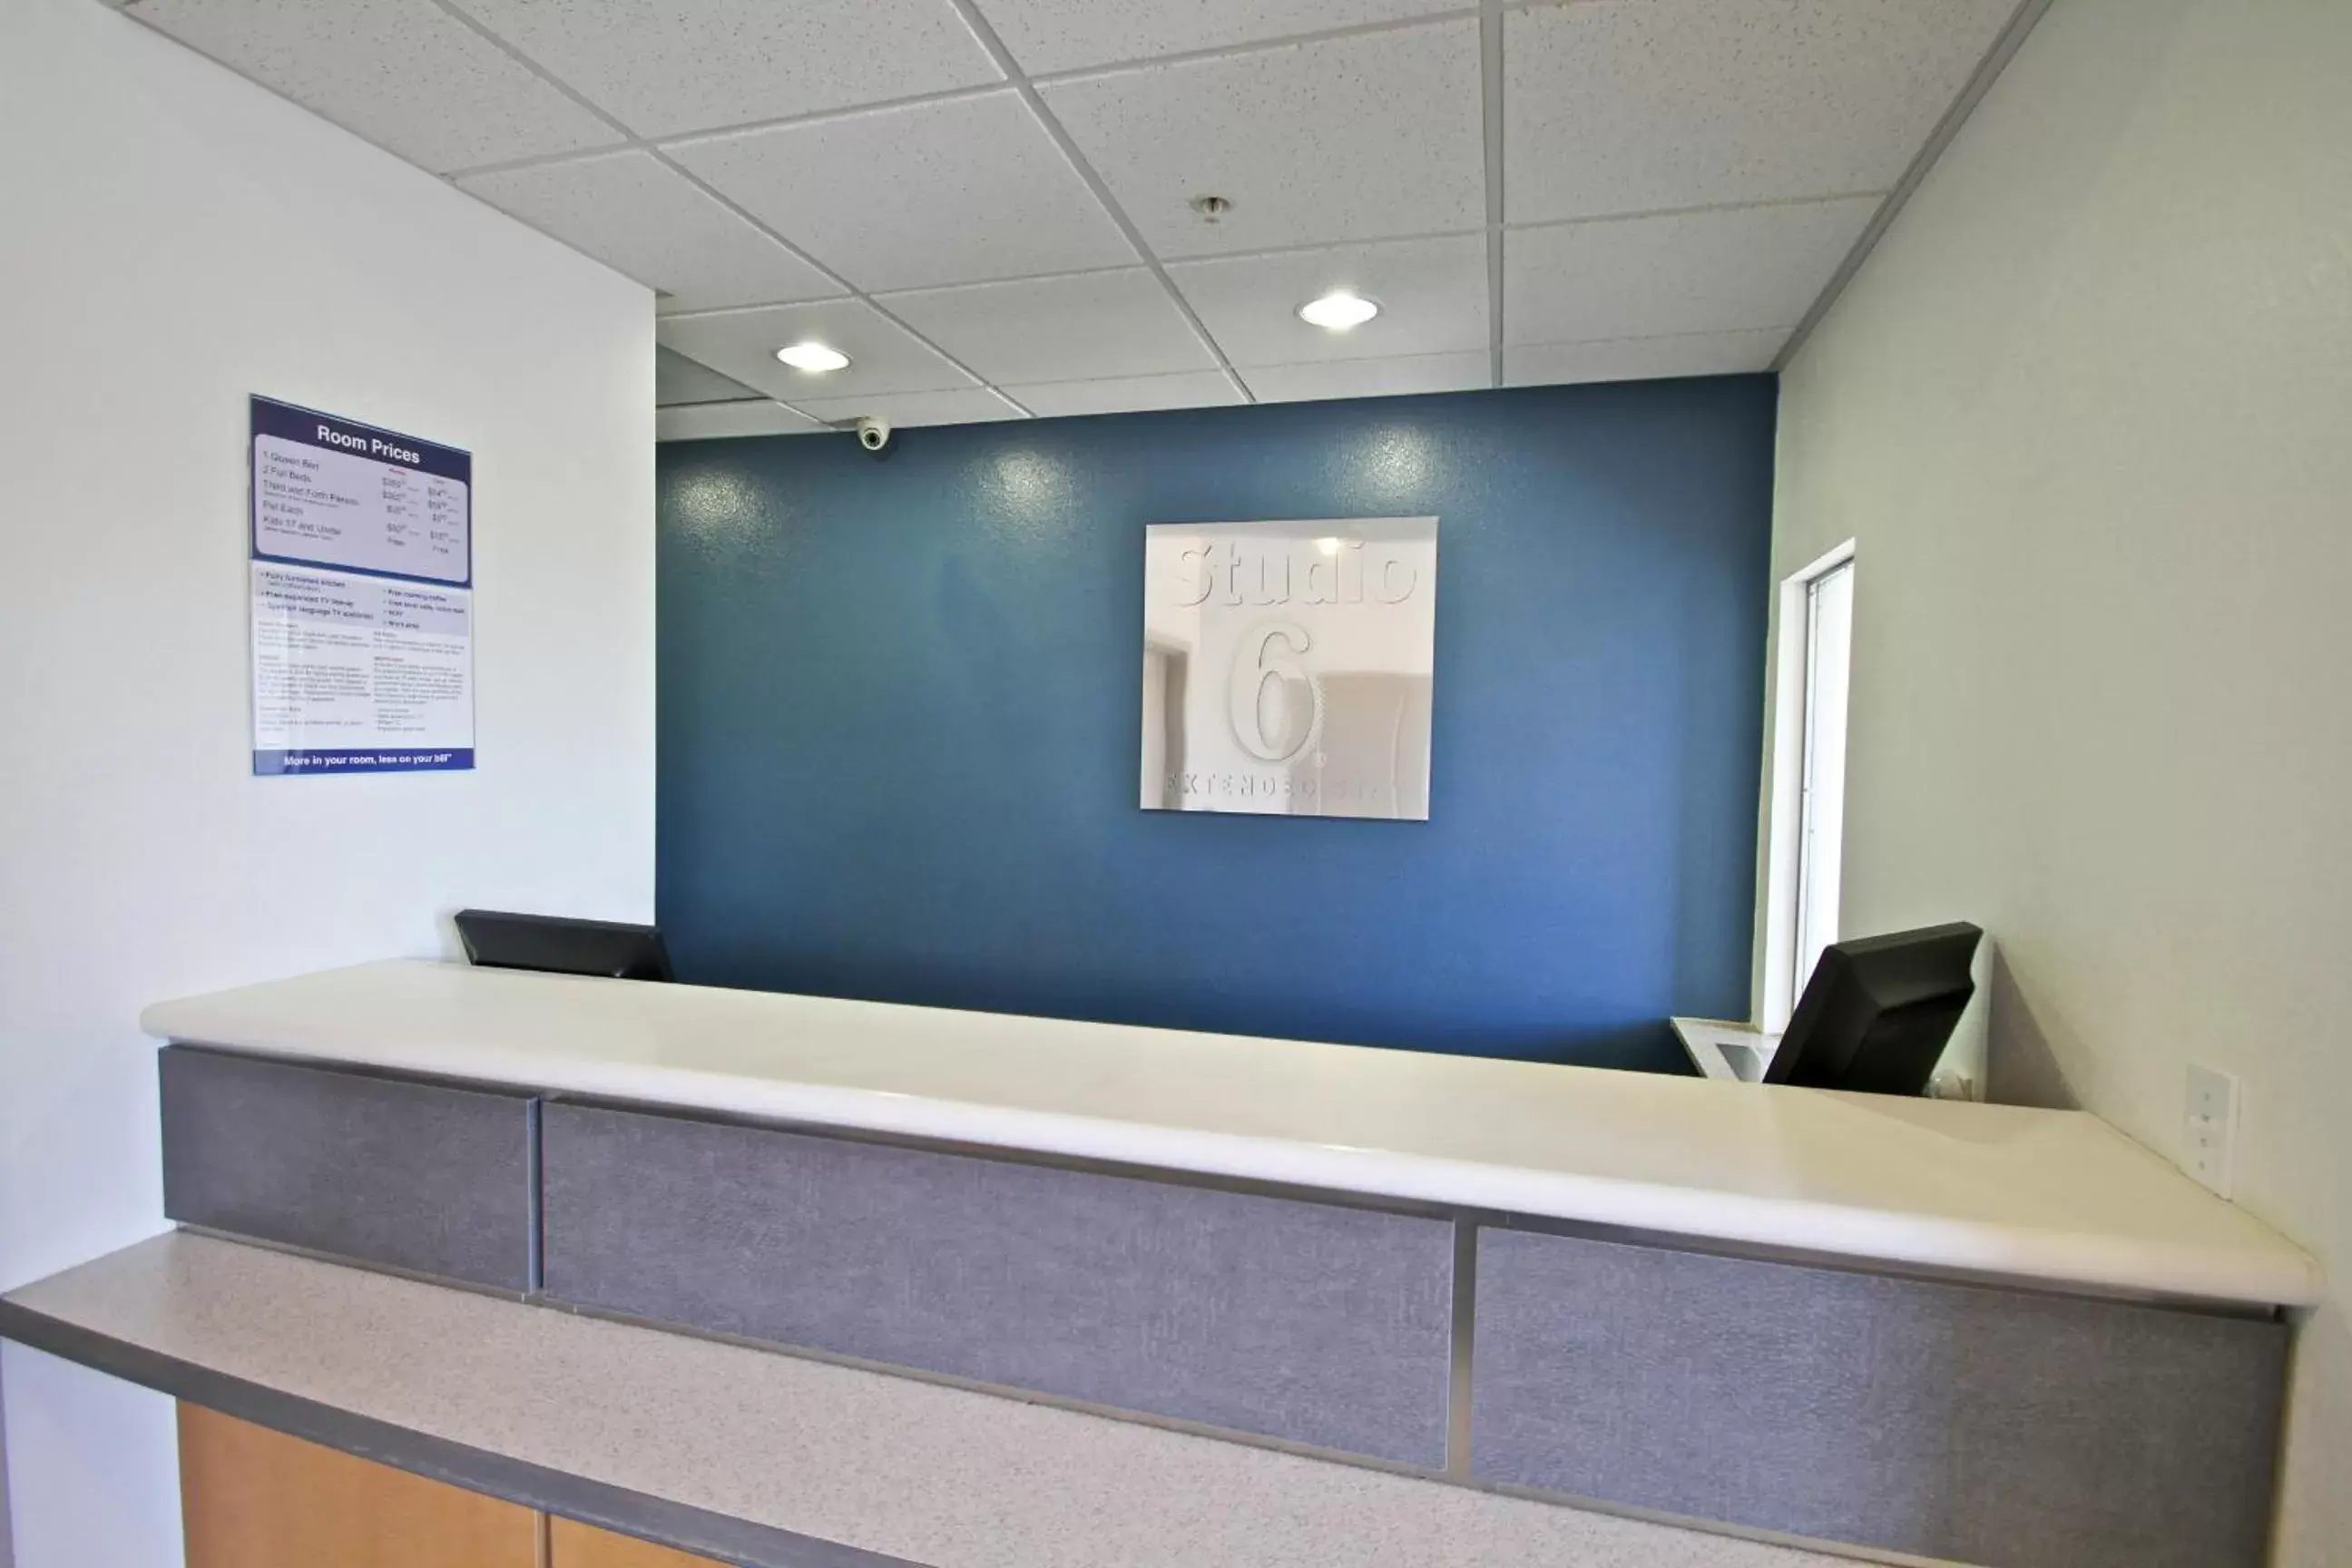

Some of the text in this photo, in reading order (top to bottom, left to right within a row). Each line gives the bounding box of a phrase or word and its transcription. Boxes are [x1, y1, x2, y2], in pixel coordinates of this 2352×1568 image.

[317, 424, 420, 464] Room Prices
[1167, 537, 1418, 607] Studio
[1228, 617, 1318, 764] 6
[284, 756, 309, 767] More
[312, 755, 322, 764] in
[324, 756, 347, 768] your
[349, 757, 377, 765] room,
[378, 755, 397, 764] less
[412, 755, 433, 766] your
